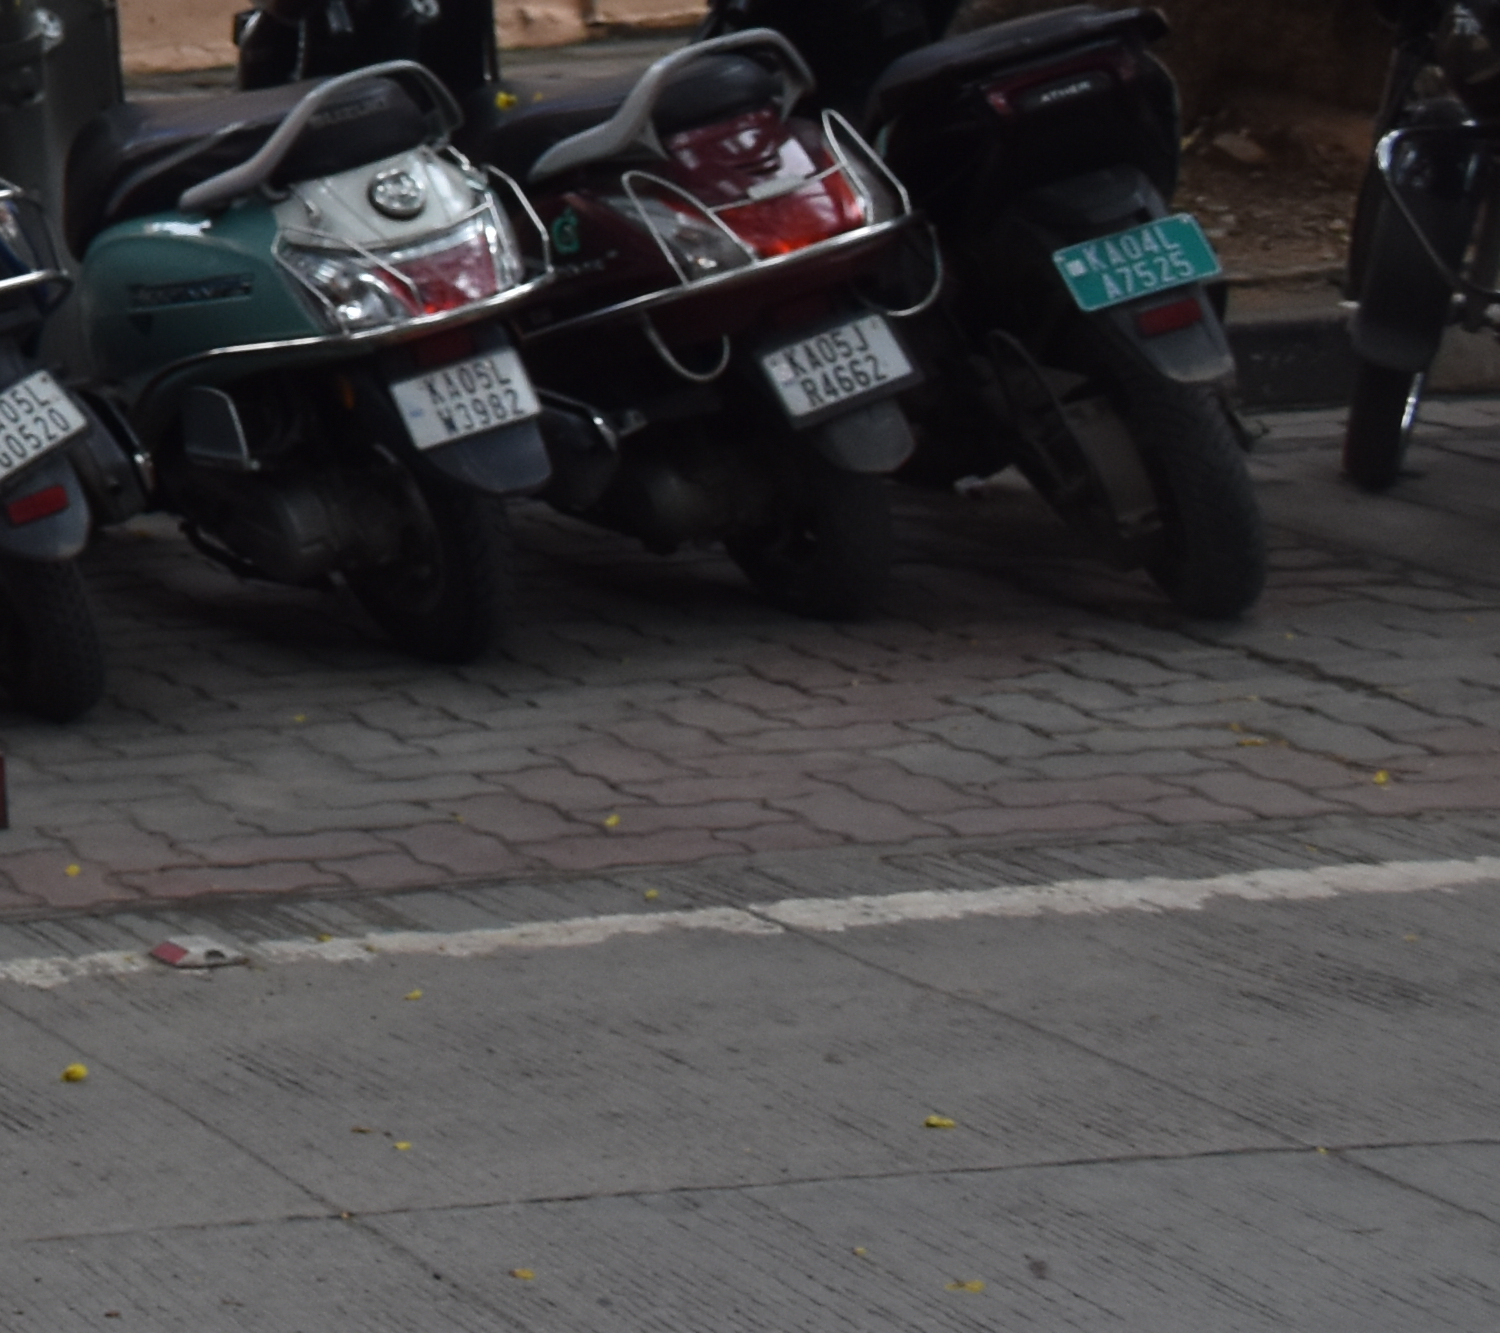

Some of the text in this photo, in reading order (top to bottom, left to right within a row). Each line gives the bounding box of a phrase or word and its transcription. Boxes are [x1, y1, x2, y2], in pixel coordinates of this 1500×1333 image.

[1081, 224, 1180, 271] KA04L
[1102, 249, 1195, 300] A7525
[783, 323, 870, 377] KA05J
[423, 358, 512, 405] KA05L
[799, 354, 888, 407] R4662
